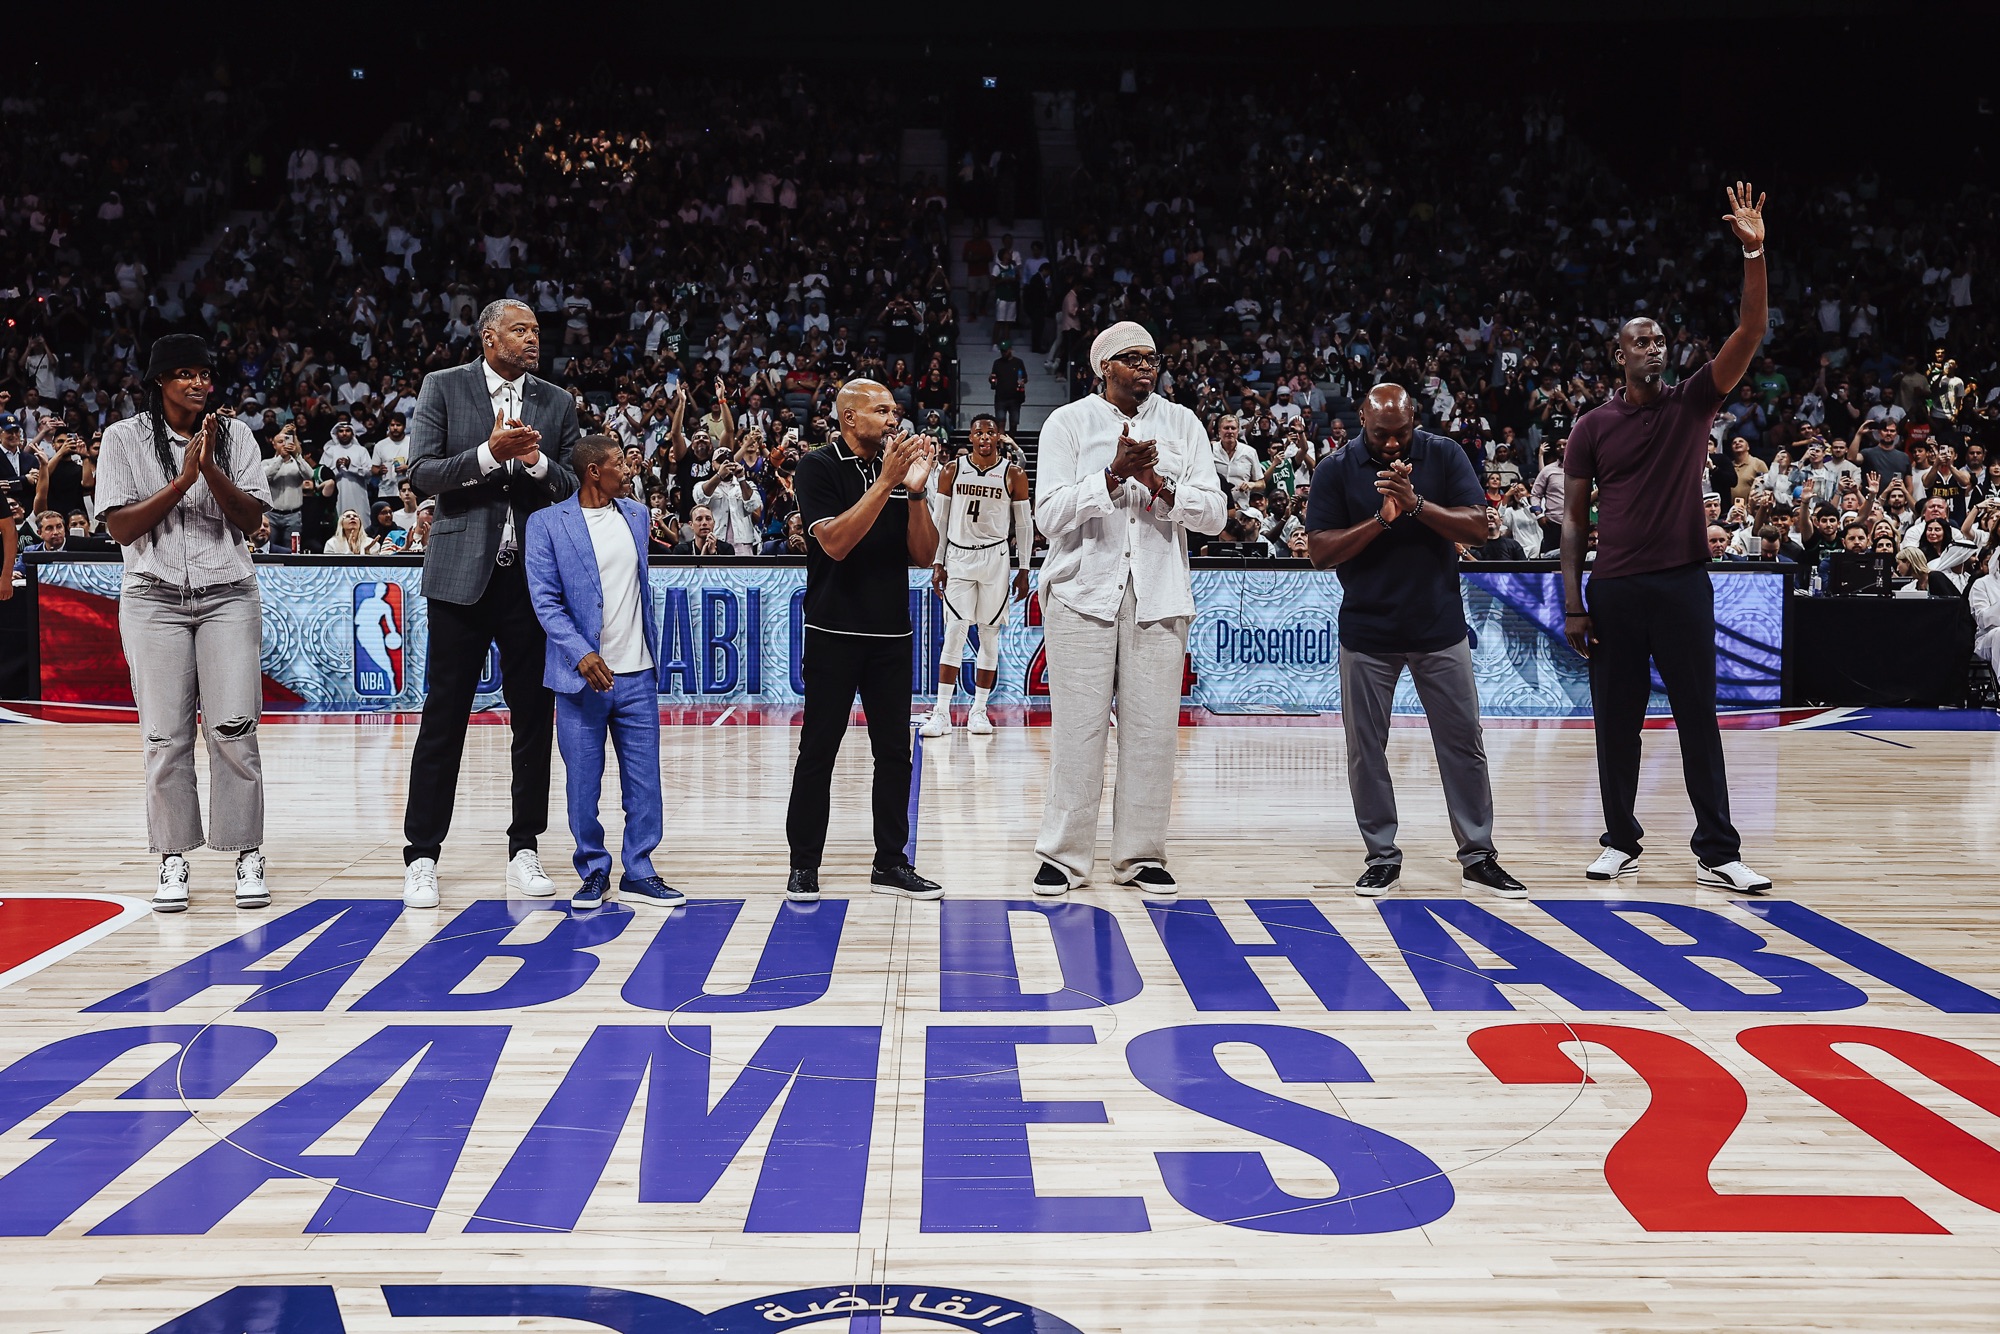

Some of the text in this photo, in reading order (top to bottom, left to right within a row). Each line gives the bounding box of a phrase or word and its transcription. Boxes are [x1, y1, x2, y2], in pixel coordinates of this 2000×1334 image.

[1553, 419, 1564, 428] 34
[956, 483, 1002, 499] NUGGETS
[966, 499, 981, 523] 4
[655, 586, 763, 696] ABI
[1216, 619, 1331, 664] Presented
[360, 671, 385, 691] NBA
[80, 900, 2000, 1013] ABU DHABI
[0, 1024, 1455, 1236] GAMES
